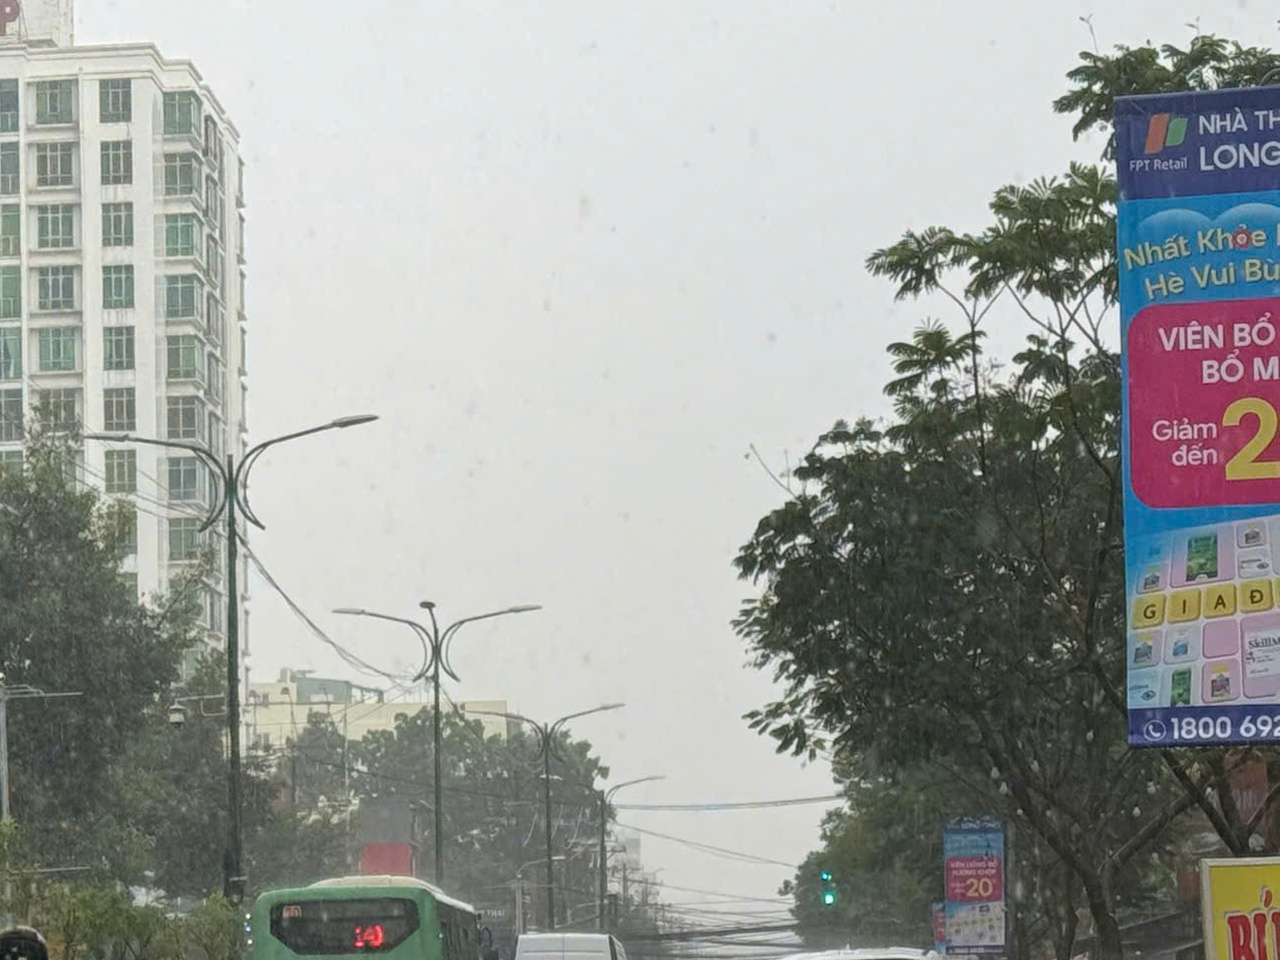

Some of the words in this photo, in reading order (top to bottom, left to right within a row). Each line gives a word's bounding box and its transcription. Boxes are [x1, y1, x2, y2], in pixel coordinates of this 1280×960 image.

[1199, 107, 1248, 135] NHÀ
[1254, 110, 1280, 130] TH
[1130, 159, 1150, 172] FPT
[1153, 157, 1188, 171] Retail
[1200, 141, 1280, 171] LONG
[1124, 233, 1192, 271] Nhất
[1197, 223, 1268, 253] Khỏe
[1145, 271, 1185, 300] Hè
[1191, 262, 1236, 289] Vui
[1244, 258, 1280, 283] Bù
[1158, 320, 1224, 352] VIÊN
[1233, 312, 1277, 347] BỔ
[1202, 350, 1245, 384] BỔ
[1152, 418, 1218, 441] Giảm
[1222, 397, 1280, 481] 2
[1172, 442, 1218, 467] đến
[1171, 716, 1232, 740] 1800
[965, 877, 994, 897] 20
